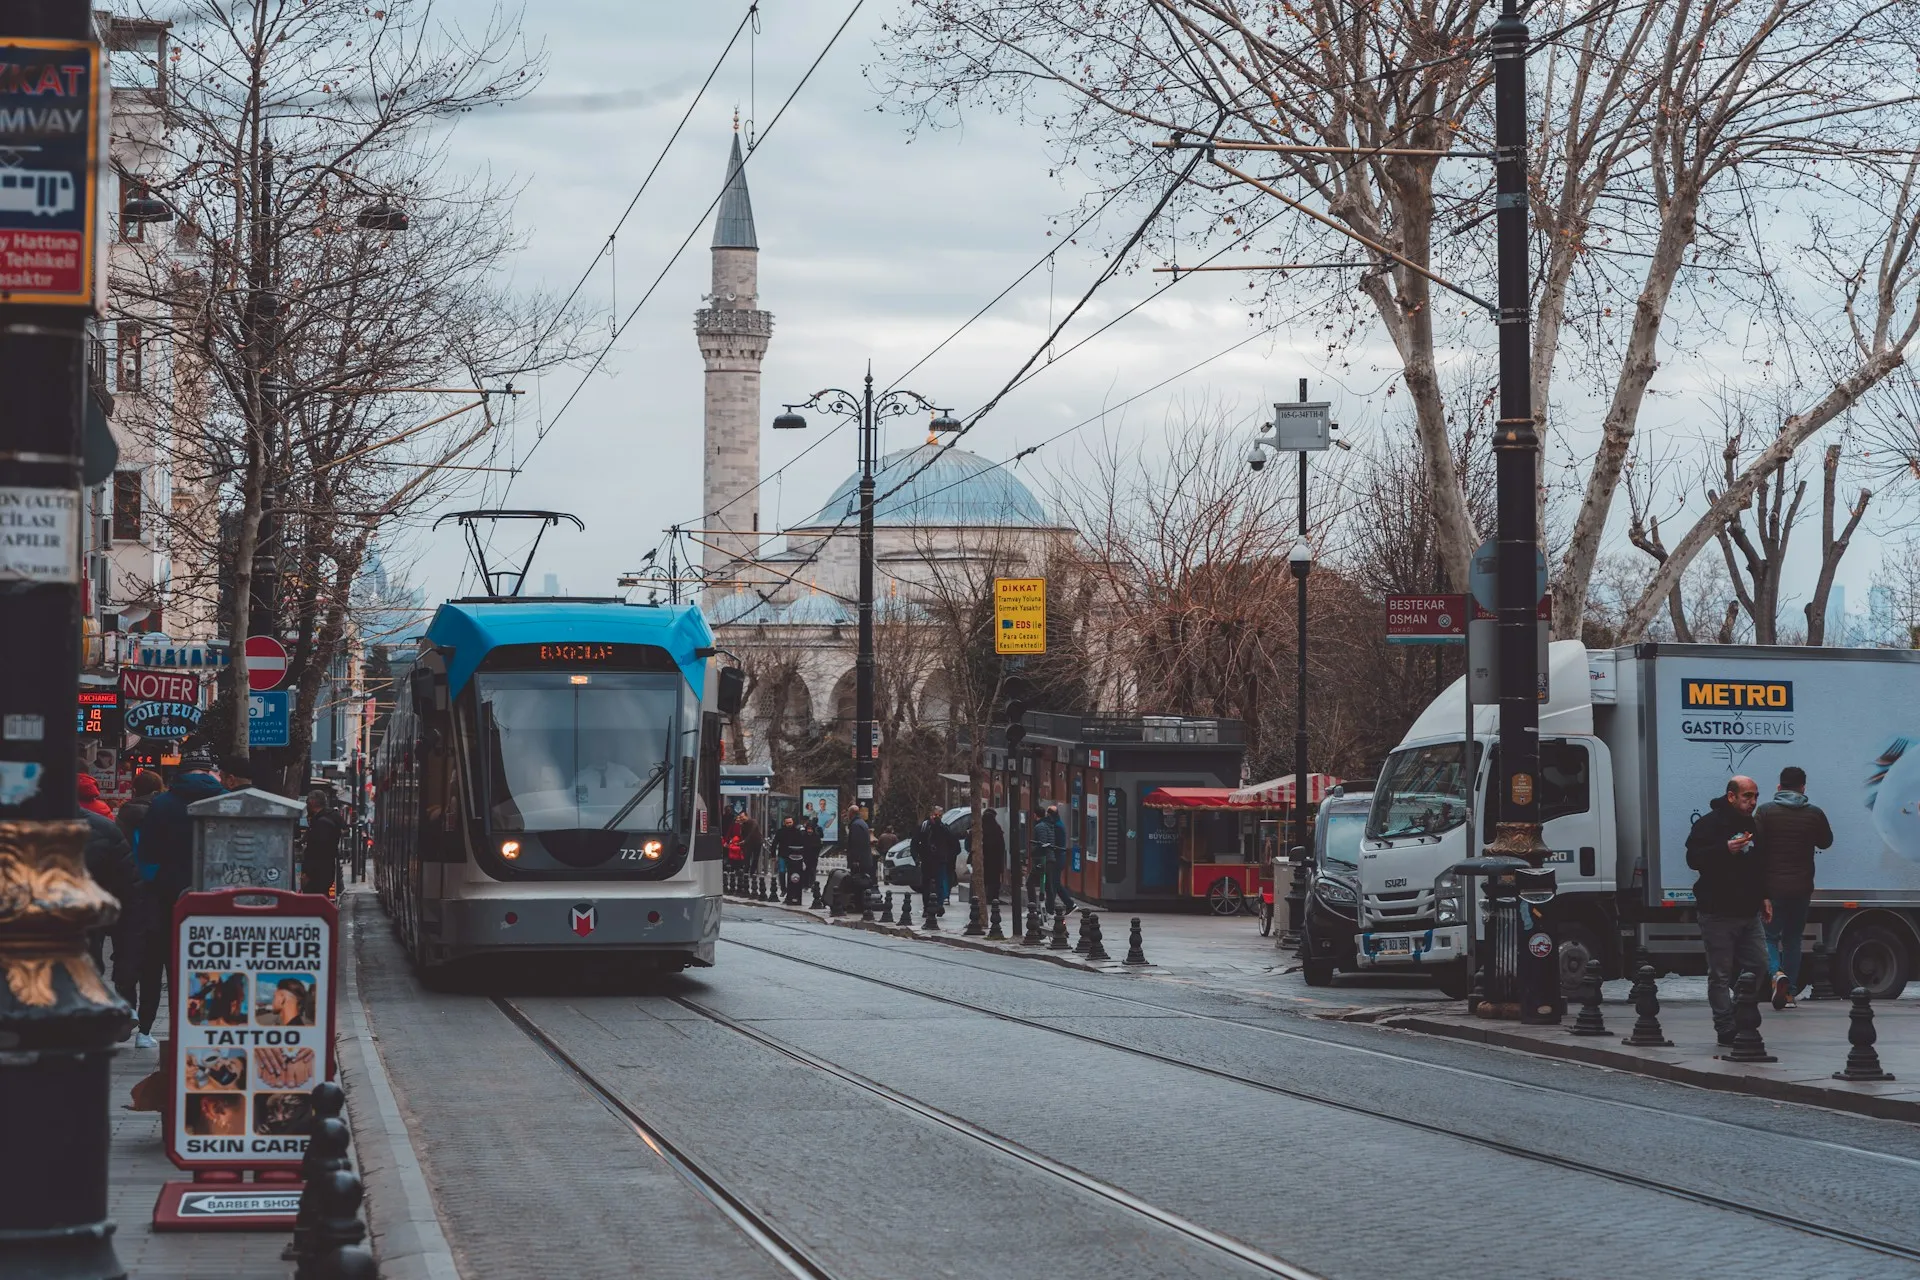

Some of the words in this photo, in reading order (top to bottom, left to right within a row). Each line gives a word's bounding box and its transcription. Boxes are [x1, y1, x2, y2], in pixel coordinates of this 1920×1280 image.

[6, 251, 76, 269] Tehlikeli
[1003, 584, 1038, 592] DİKKAT
[999, 595, 1022, 603] Tramvay
[1389, 600, 1445, 610] BESTEKAR
[1016, 621, 1031, 629] EDS
[1389, 614, 1428, 625] OSMAN
[123, 673, 193, 701] NOTER
[79, 694, 115, 702] EXCHANGE
[1688, 683, 1787, 706] METRO
[127, 702, 202, 727] COIFFEUR
[145, 725, 187, 737] Tattoo
[620, 849, 645, 860] 727
[1385, 878, 1407, 888] ISUZU
[189, 926, 214, 940] BAY
[224, 926, 266, 940] BAYAN
[270, 924, 320, 941] KUAFÖR
[188, 941, 321, 958] COIFFEUR
[187, 960, 231, 970] MAN
[246, 960, 321, 971] WOMAN
[204, 1031, 300, 1045] TATTOO
[187, 1140, 244, 1153] SKIN
[207, 1200, 260, 1209] BARBER
